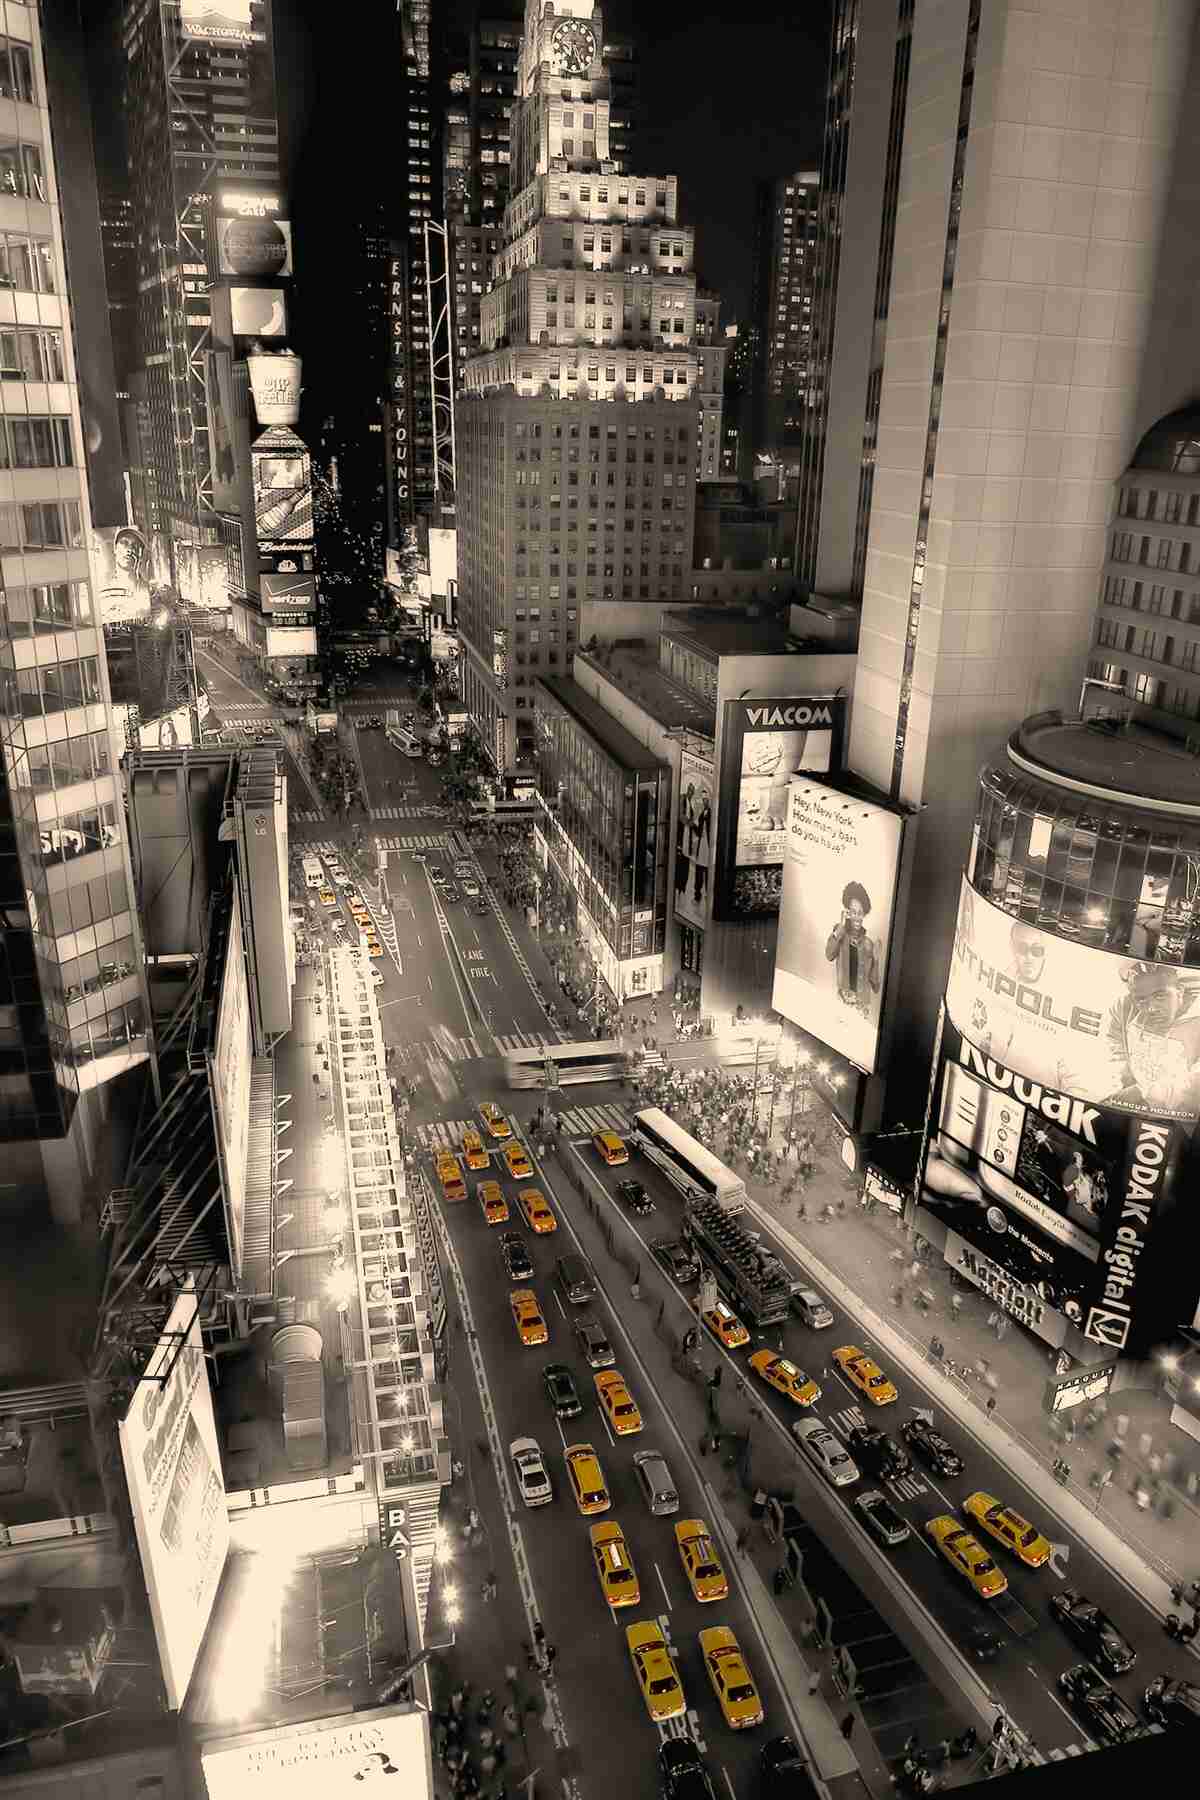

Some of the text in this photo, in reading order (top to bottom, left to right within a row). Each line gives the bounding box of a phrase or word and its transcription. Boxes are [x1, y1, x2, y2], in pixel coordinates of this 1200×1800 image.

[391, 261, 408, 498] ERNST & YOUNG
[746, 706, 833, 726] VIACOM
[462, 949, 488, 960] LANE
[470, 967, 490, 977] FIRE
[1150, 1106, 1195, 1118] HOUSTON
[1102, 1123, 1169, 1312] KODAK digital
